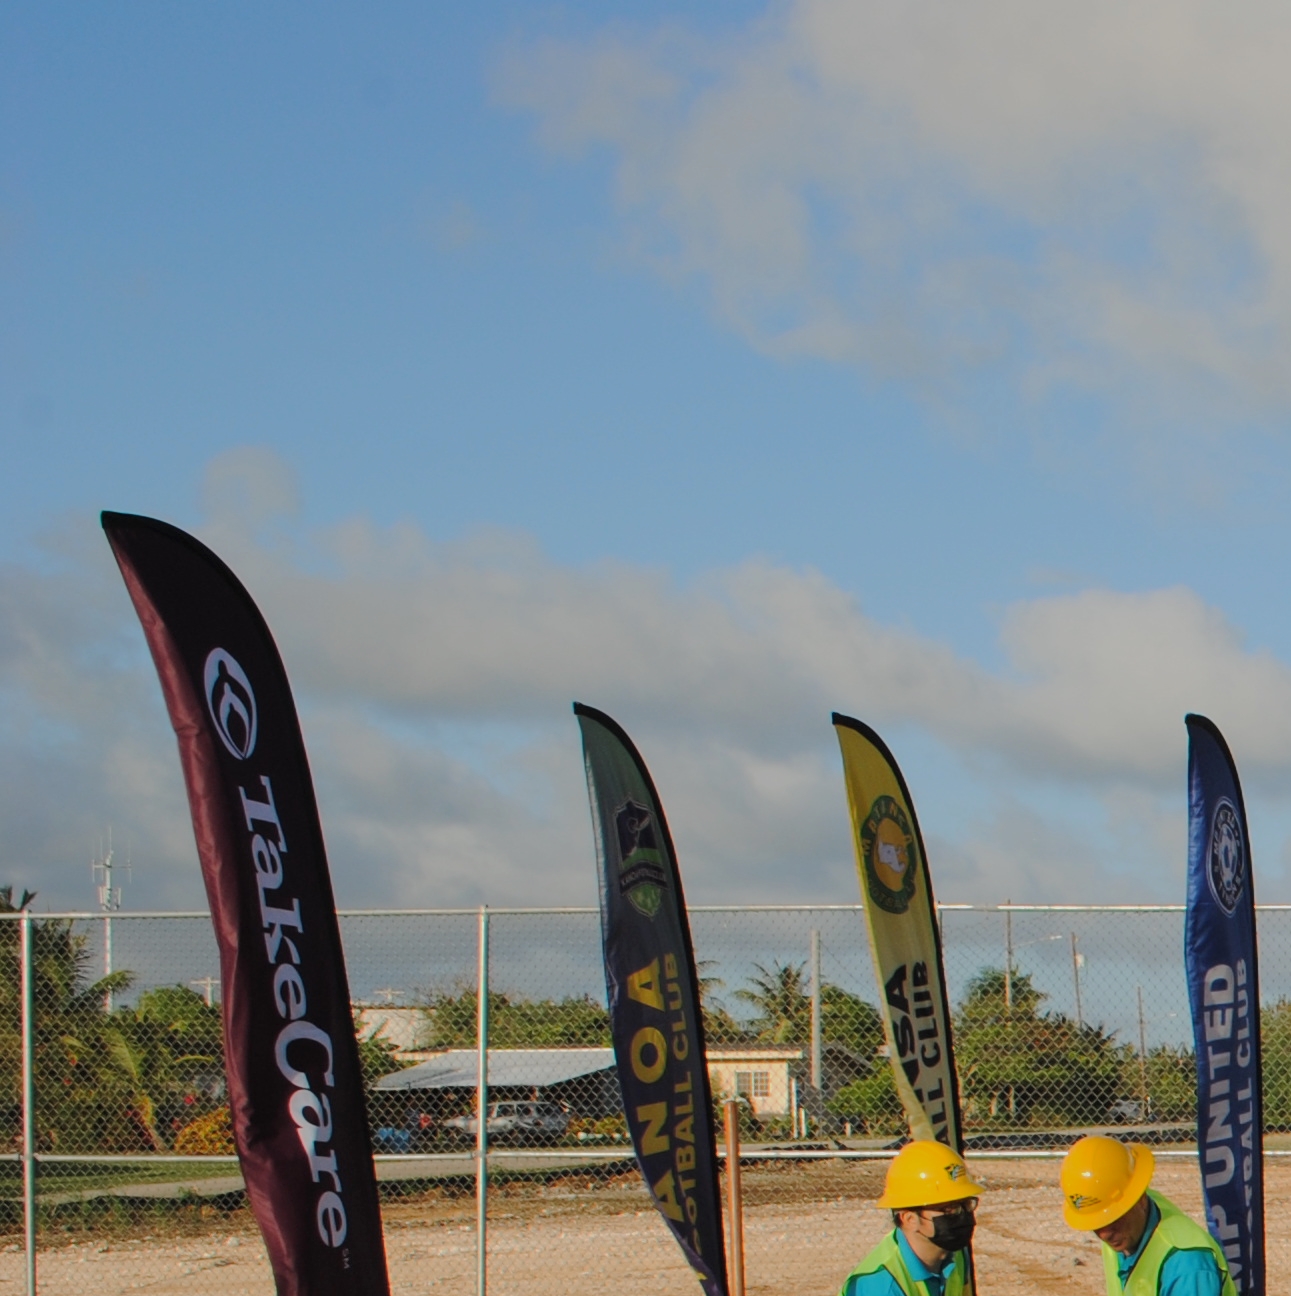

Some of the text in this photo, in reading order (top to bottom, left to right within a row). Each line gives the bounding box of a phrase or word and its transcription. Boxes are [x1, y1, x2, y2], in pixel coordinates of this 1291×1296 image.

[239, 775, 348, 1248] TakeCare
[663, 952, 689, 1061] CLUB
[912, 960, 942, 1069] CLUB
[1203, 963, 1236, 1189] UNITED
[1236, 957, 1252, 1069] CLUB
[627, 957, 692, 1250] ANOA
